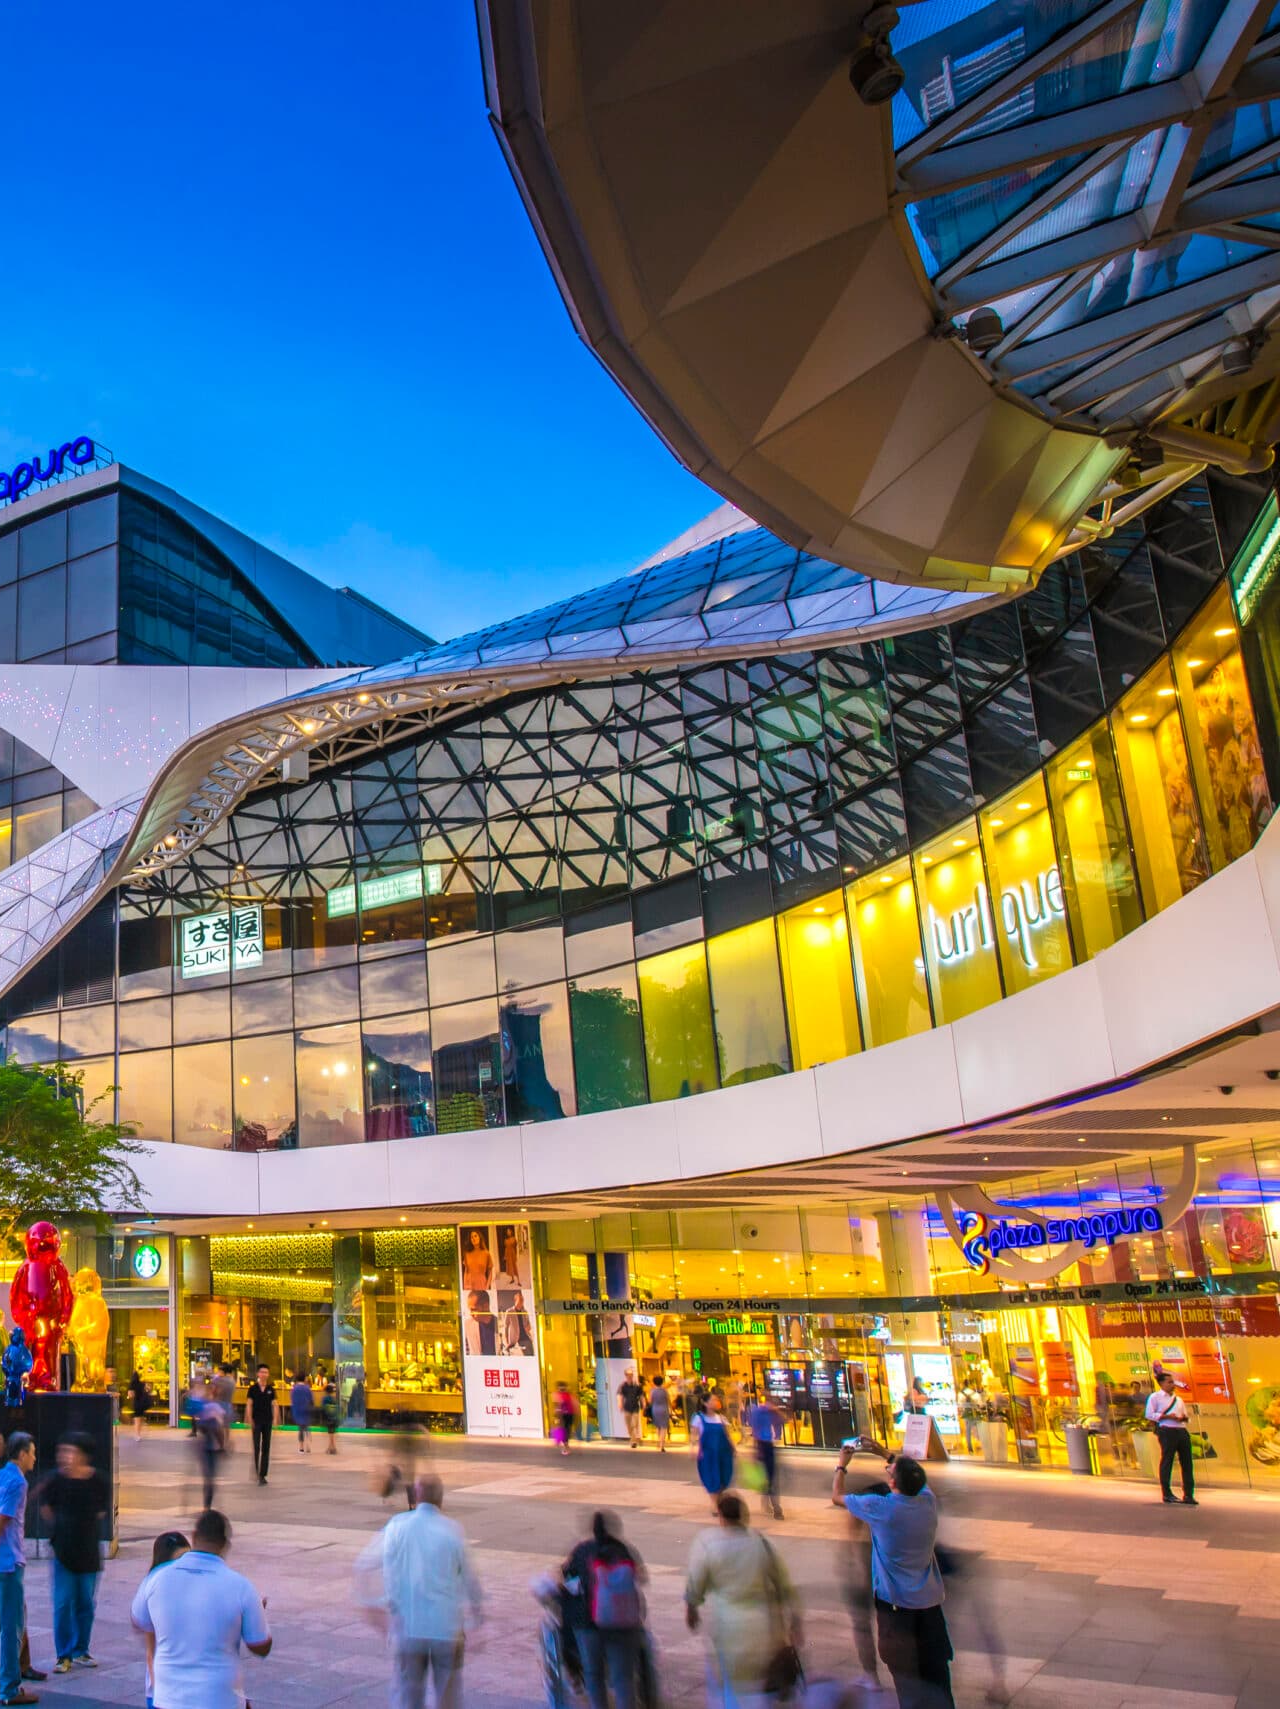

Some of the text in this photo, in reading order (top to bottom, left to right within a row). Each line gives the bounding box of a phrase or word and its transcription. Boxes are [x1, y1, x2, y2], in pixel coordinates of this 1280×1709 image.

[189, 911, 258, 947] すき屋
[183, 943, 262, 968] SUKI YA
[988, 1207, 1160, 1257] plaza singapura
[1078, 1287, 1101, 1299] Lane
[1125, 1280, 1206, 1298] Open 24 Hours
[563, 1300, 669, 1312] Link to Handy Road
[693, 1300, 780, 1312] Open 24 Hours
[1150, 1310, 1161, 1323] IN
[1163, 1308, 1215, 1323] NOVEMBER
[486, 1406, 522, 1415] LEVEL 3
